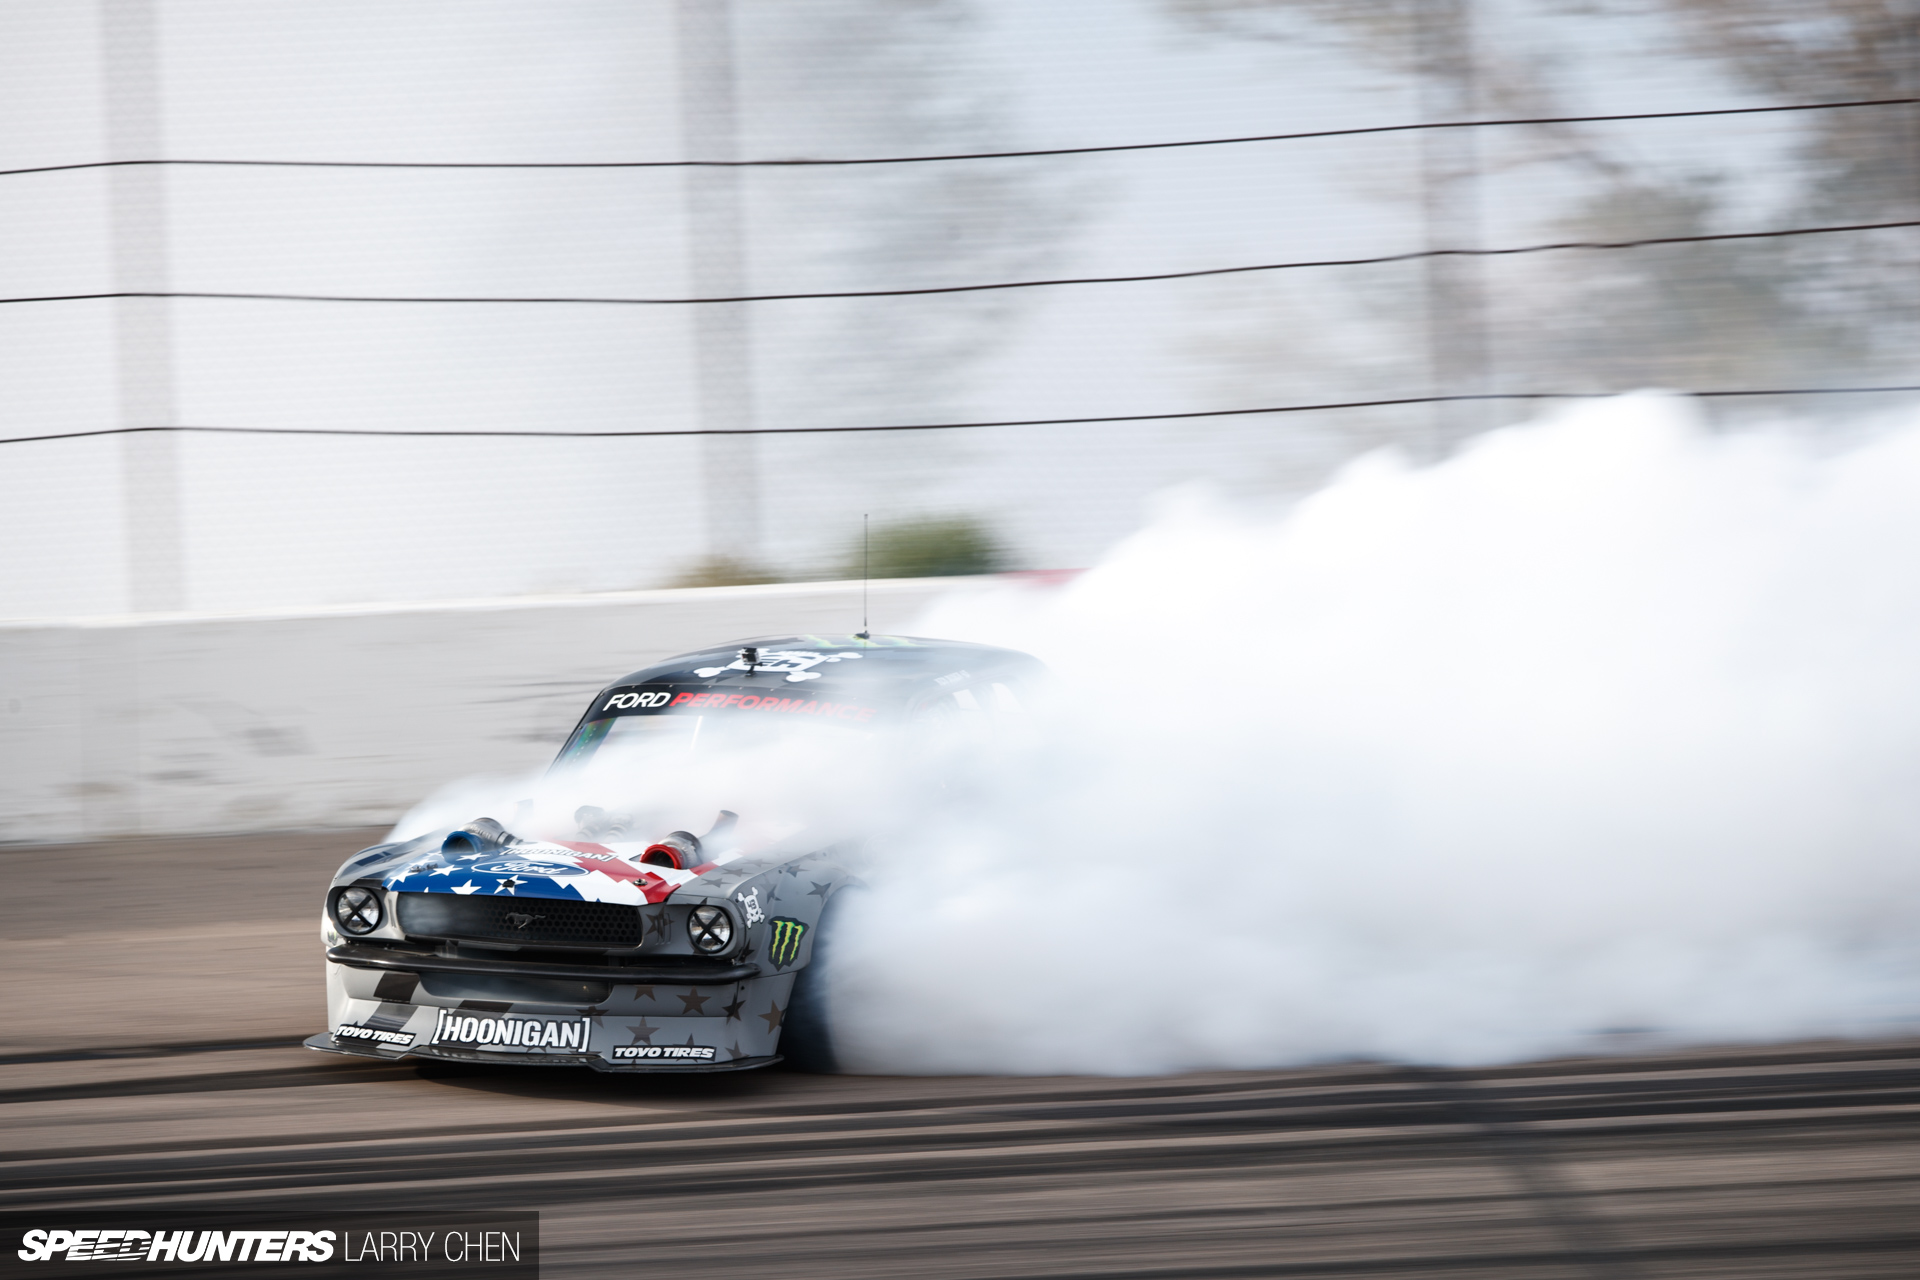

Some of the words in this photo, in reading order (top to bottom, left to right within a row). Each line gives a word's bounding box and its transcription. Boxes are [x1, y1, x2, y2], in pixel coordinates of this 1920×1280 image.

[602, 691, 672, 711] FORD
[669, 692, 877, 722] PERFORMANCE
[490, 861, 569, 875] Ford
[336, 1025, 373, 1040] TOYO
[372, 1030, 414, 1045] TIRES
[432, 1009, 590, 1052] [HOONIGAN]
[614, 1047, 661, 1058] TOYO
[663, 1047, 715, 1059] TIRES
